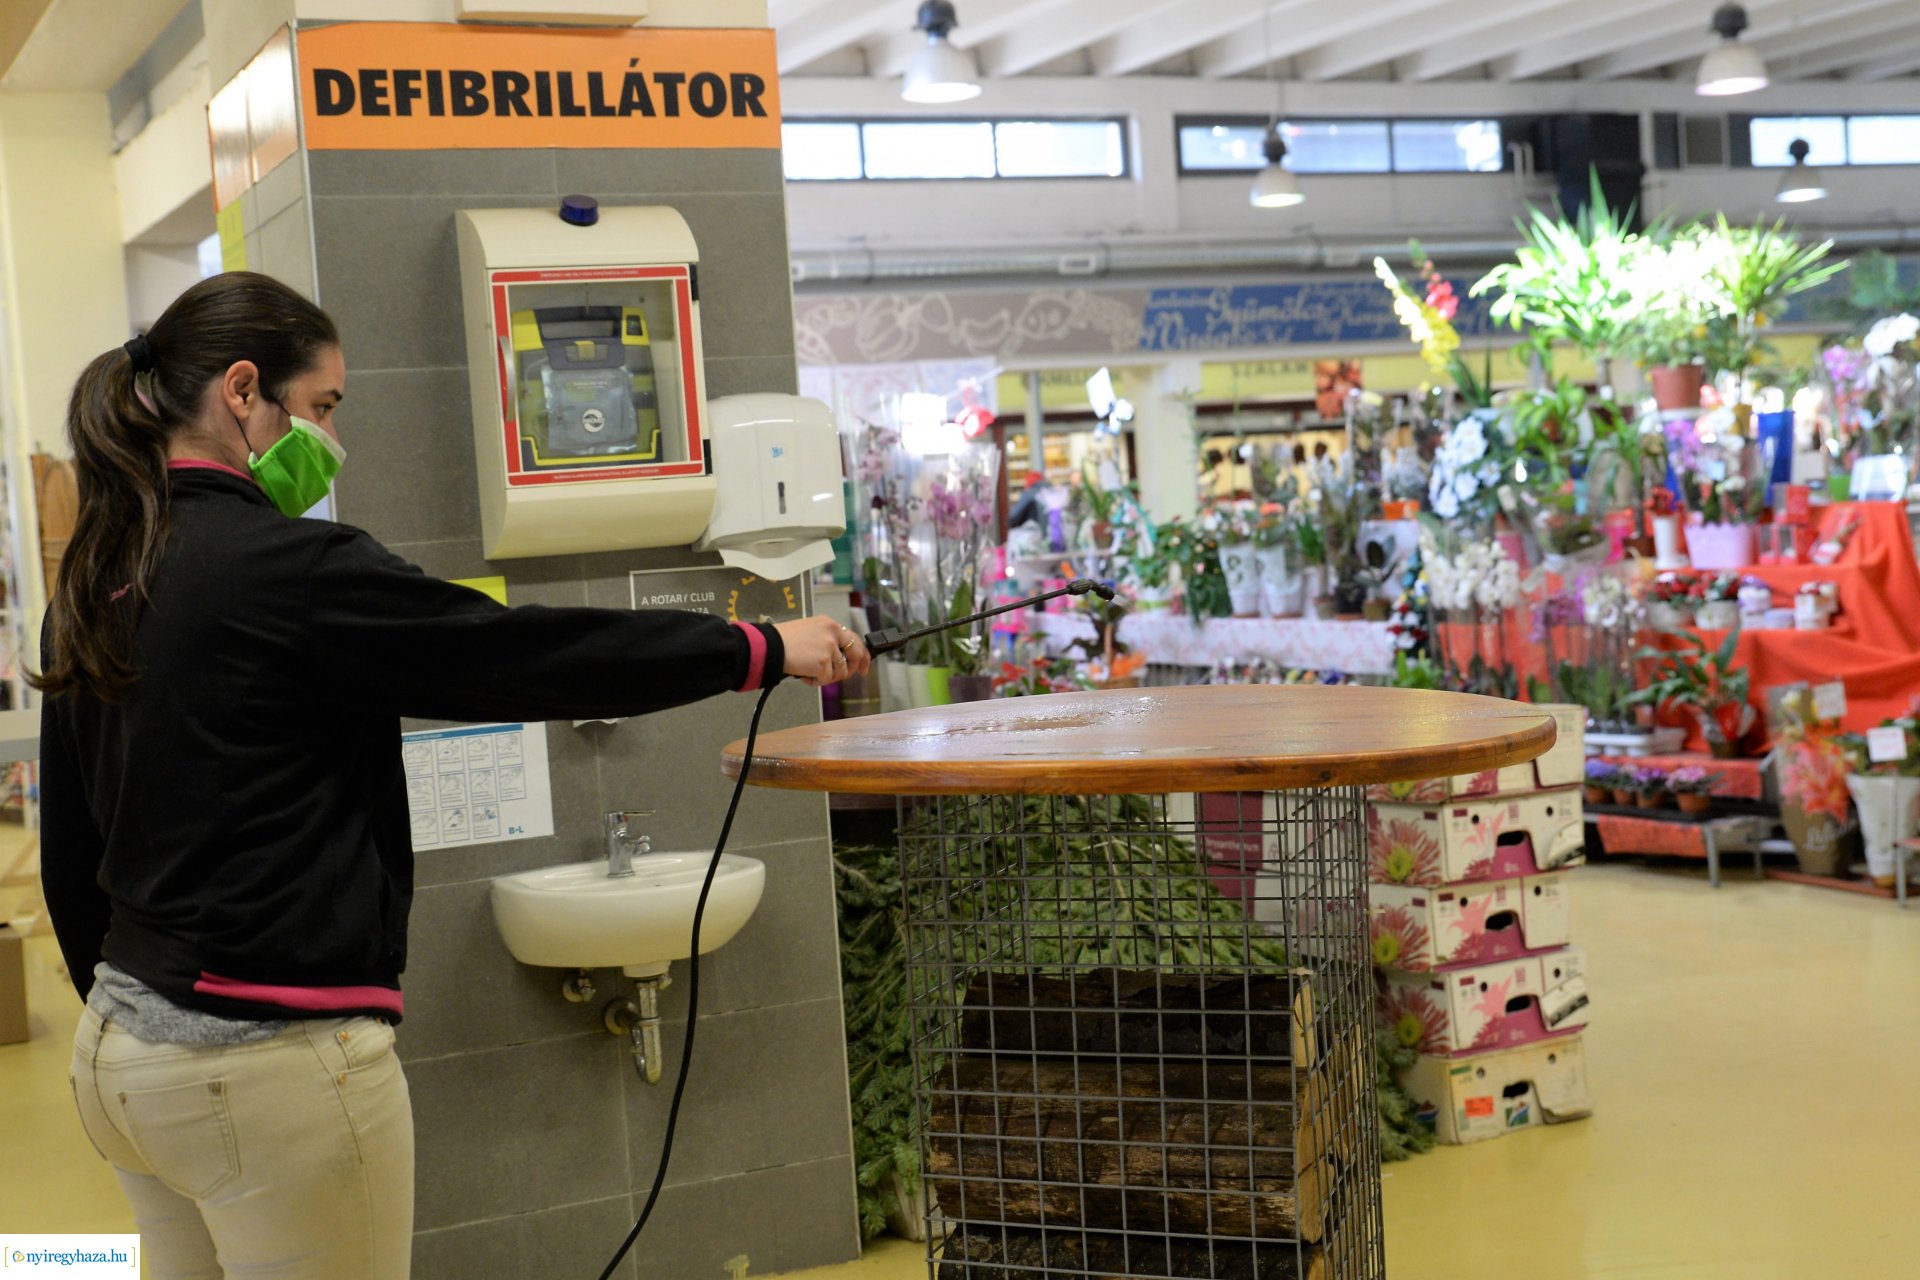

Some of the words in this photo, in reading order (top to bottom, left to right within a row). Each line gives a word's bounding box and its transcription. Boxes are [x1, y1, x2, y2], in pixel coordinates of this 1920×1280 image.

[313, 57, 768, 118] DEFIBRILLÁTOR
[641, 597, 649, 605] A
[651, 594, 688, 606] ROTARY
[690, 592, 715, 602] CLUB
